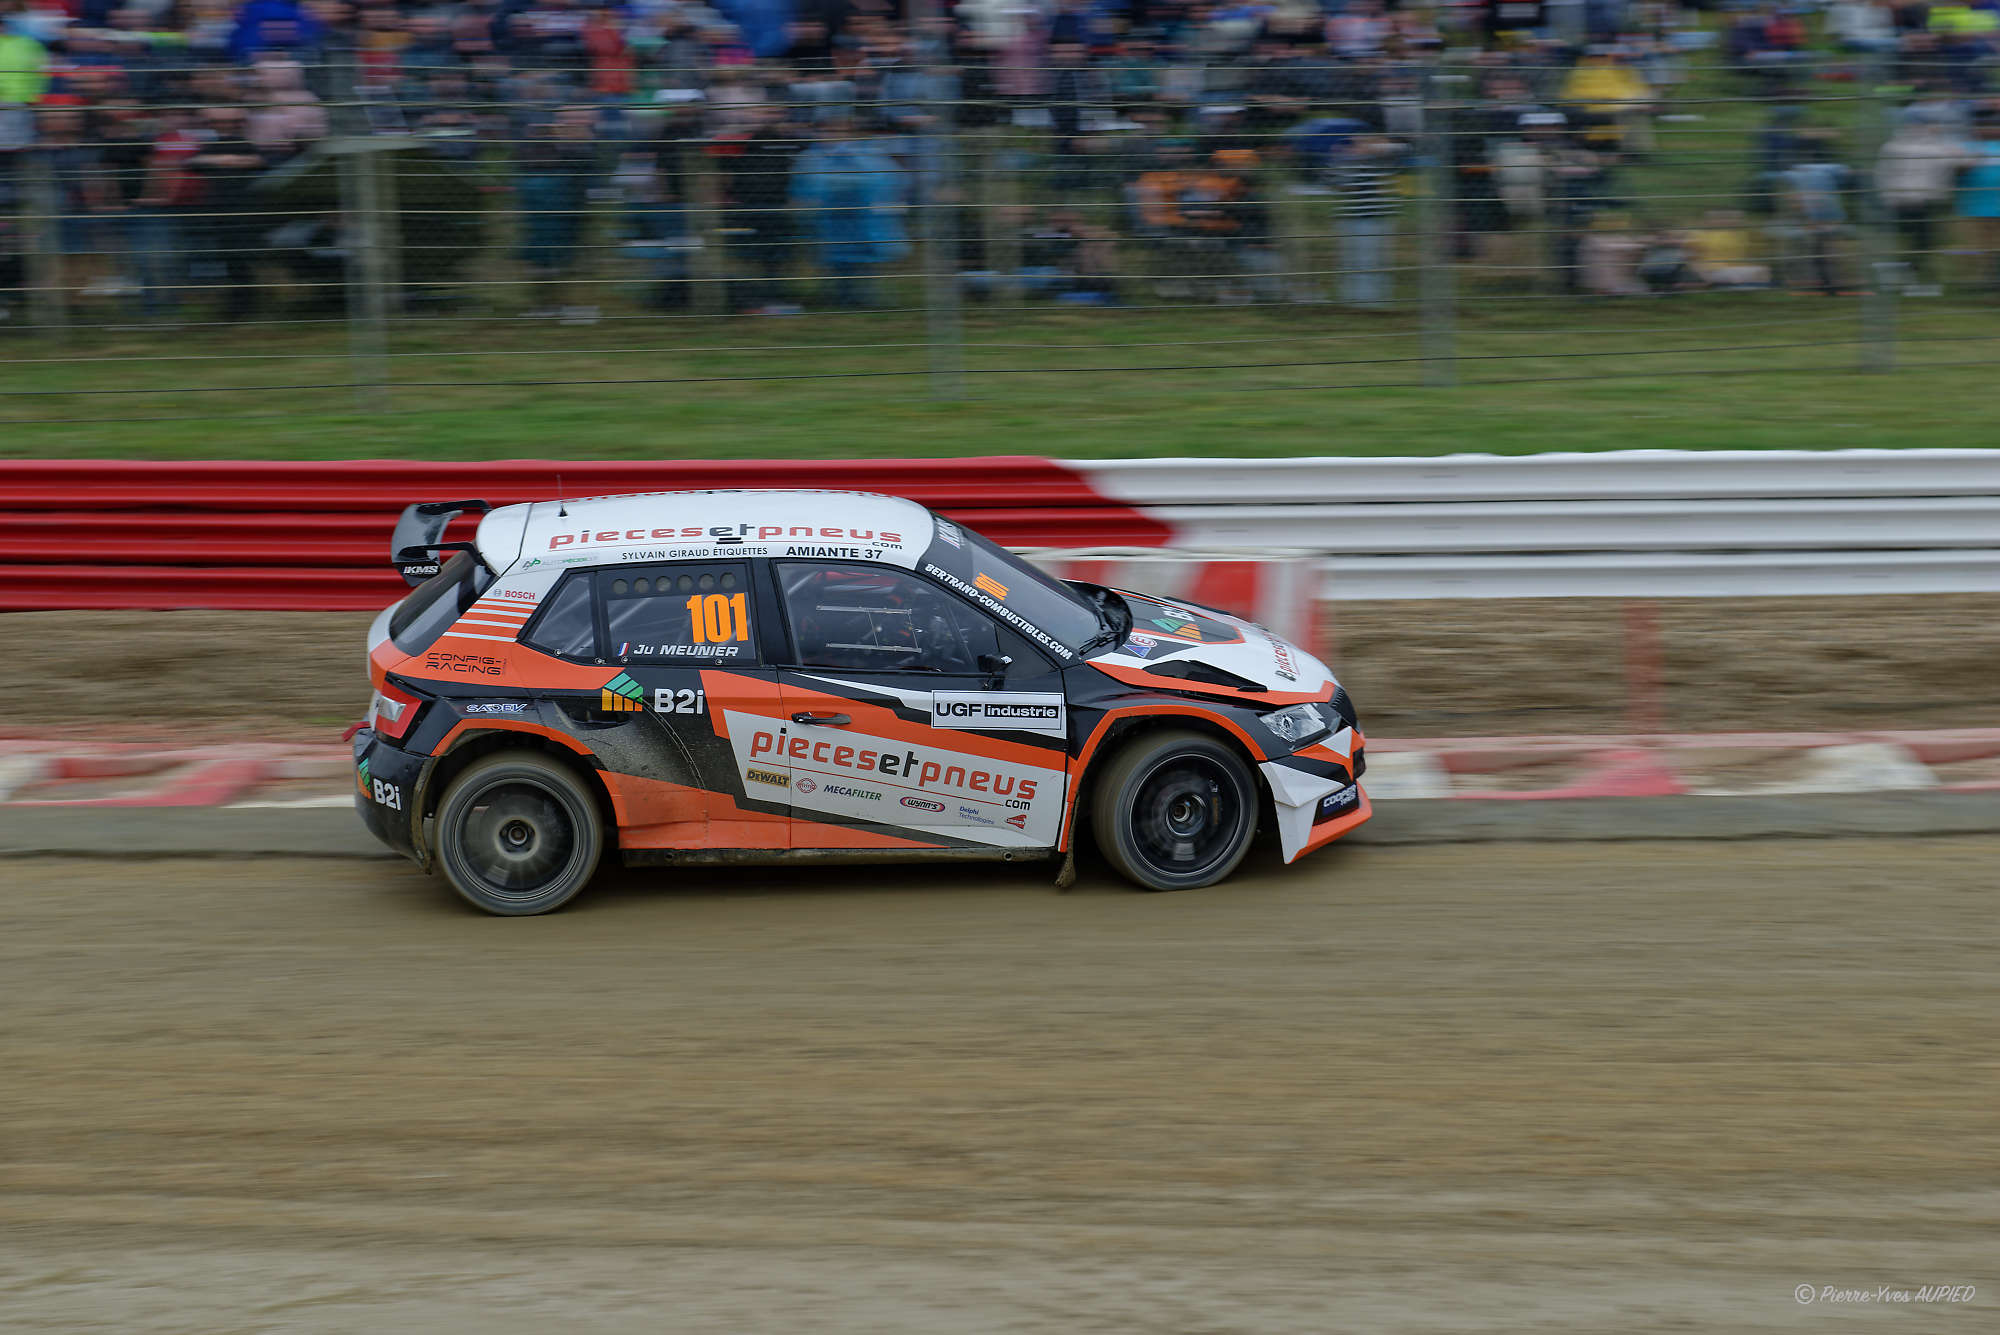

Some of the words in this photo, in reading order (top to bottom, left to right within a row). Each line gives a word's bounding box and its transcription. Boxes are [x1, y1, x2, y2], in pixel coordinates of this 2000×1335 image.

[622, 551, 666, 560] SYLVAIN
[669, 549, 710, 558] GIRAUD
[712, 547, 768, 557] ÉTIQUETTES
[786, 546, 860, 558] AMIANTE
[864, 549, 883, 560] 37
[504, 590, 536, 600] BOSCH
[686, 592, 749, 644] 101
[924, 563, 1073, 660] BERTRAND-COMBUSTIBLES.COM
[633, 644, 654, 655] Ju
[659, 644, 739, 657] MEUNIER
[426, 652, 503, 665] CONFIG-
[425, 661, 502, 676] RACING
[653, 688, 705, 715] B2i
[935, 702, 983, 717] UGF
[986, 704, 1058, 718] industrie
[750, 727, 1038, 800] piecesetpneus
[373, 778, 401, 811] B2i
